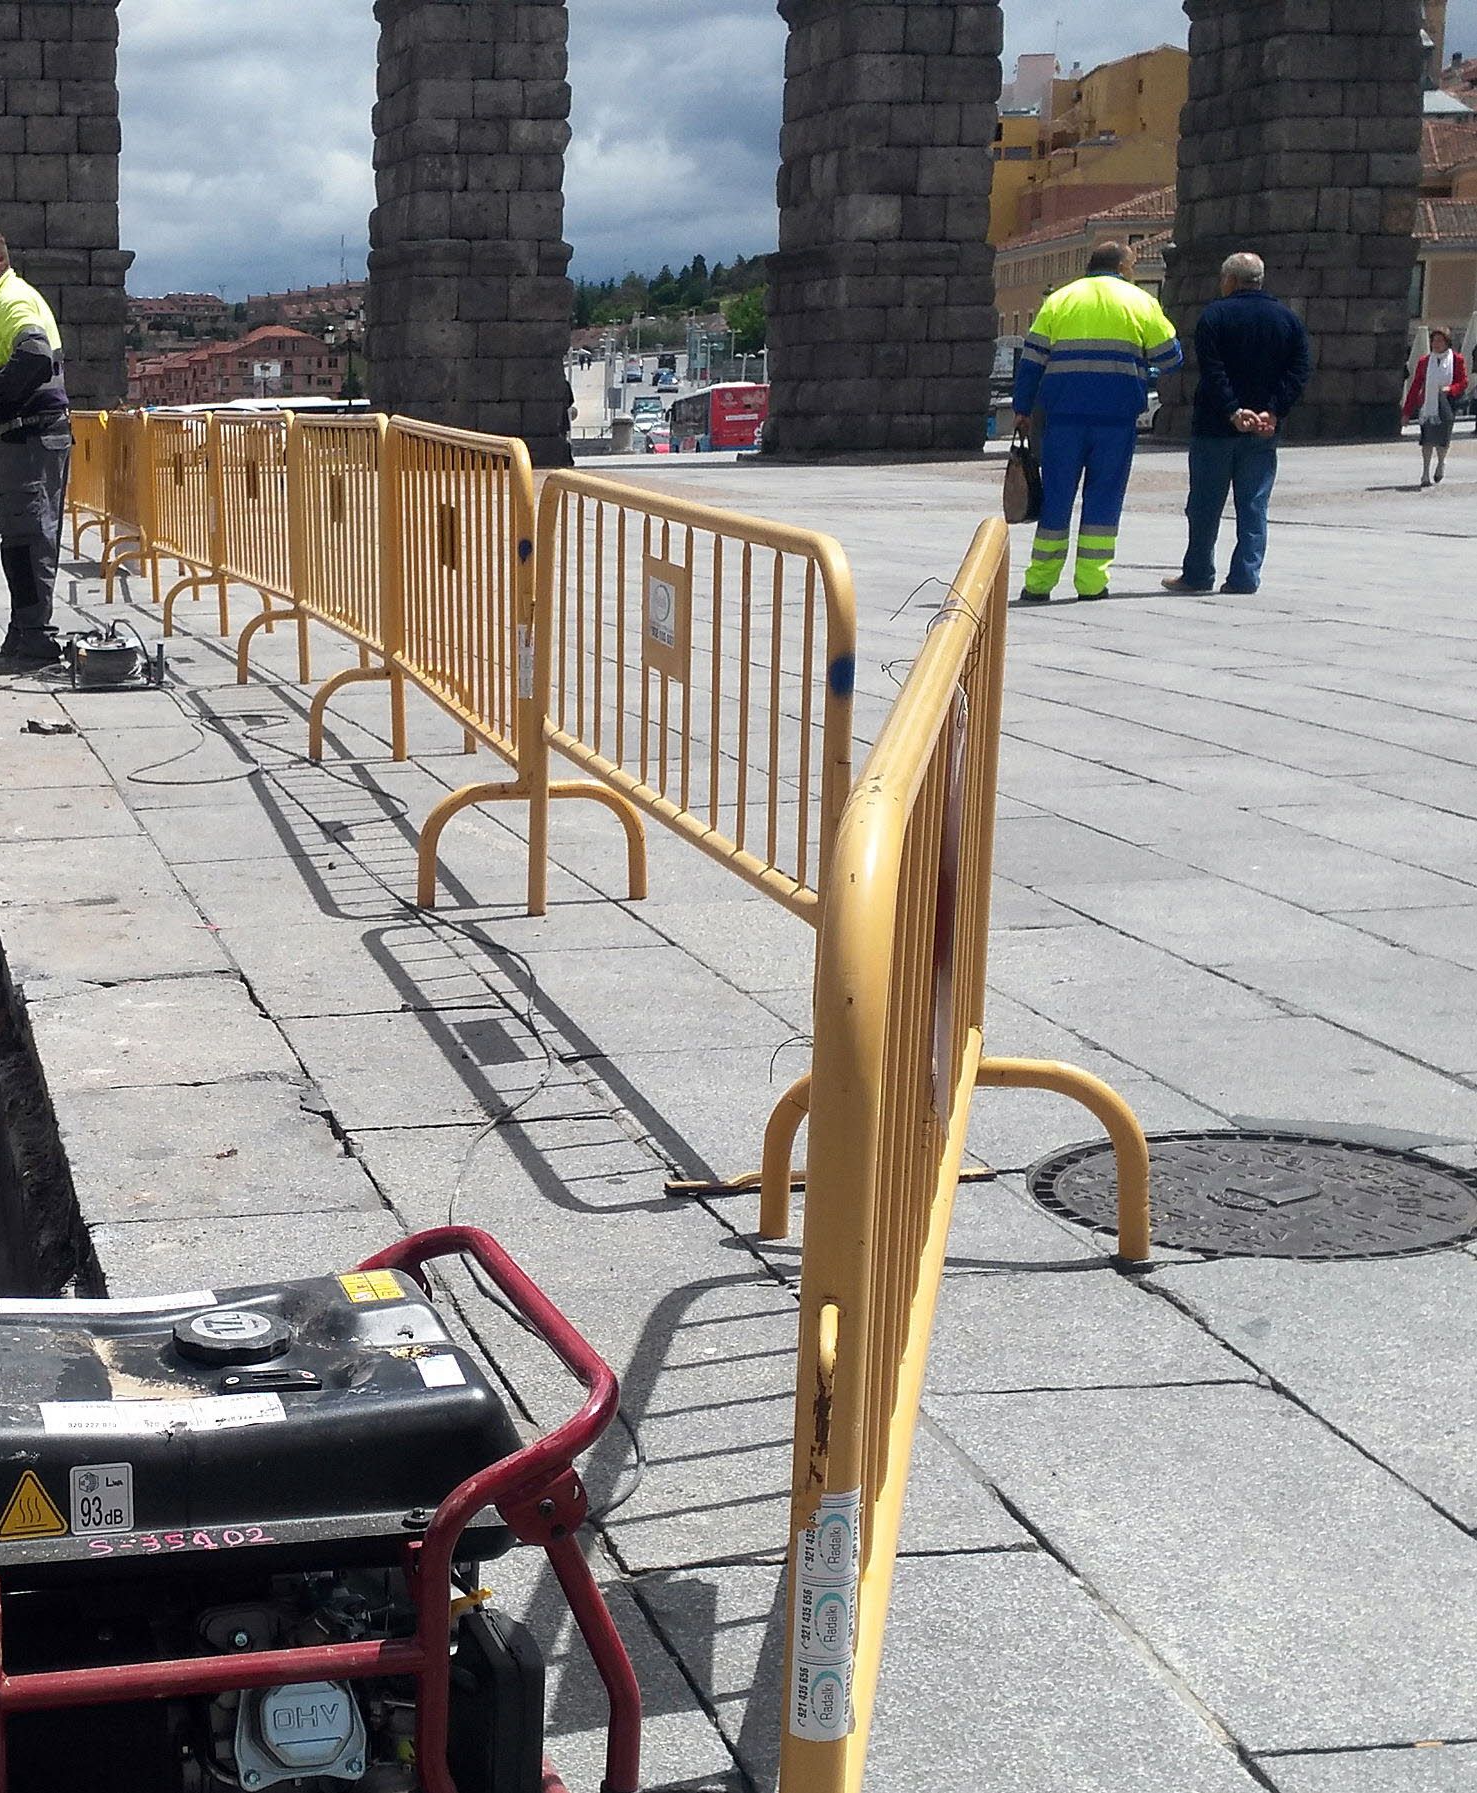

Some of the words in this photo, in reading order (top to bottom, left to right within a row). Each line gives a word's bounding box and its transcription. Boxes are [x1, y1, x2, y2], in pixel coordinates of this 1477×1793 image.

[827, 1526, 842, 1565] Radalki
[804, 1546, 814, 1563] 921
[802, 1588, 812, 1605] 656
[802, 1606, 812, 1623] 435
[824, 1604, 839, 1643] Radalki
[801, 1624, 811, 1641] 921
[799, 1667, 809, 1684] 656
[798, 1684, 809, 1701] 435
[797, 1702, 808, 1719] 921
[820, 1683, 835, 1721] Radalki
[273, 1703, 339, 1729] OHV
